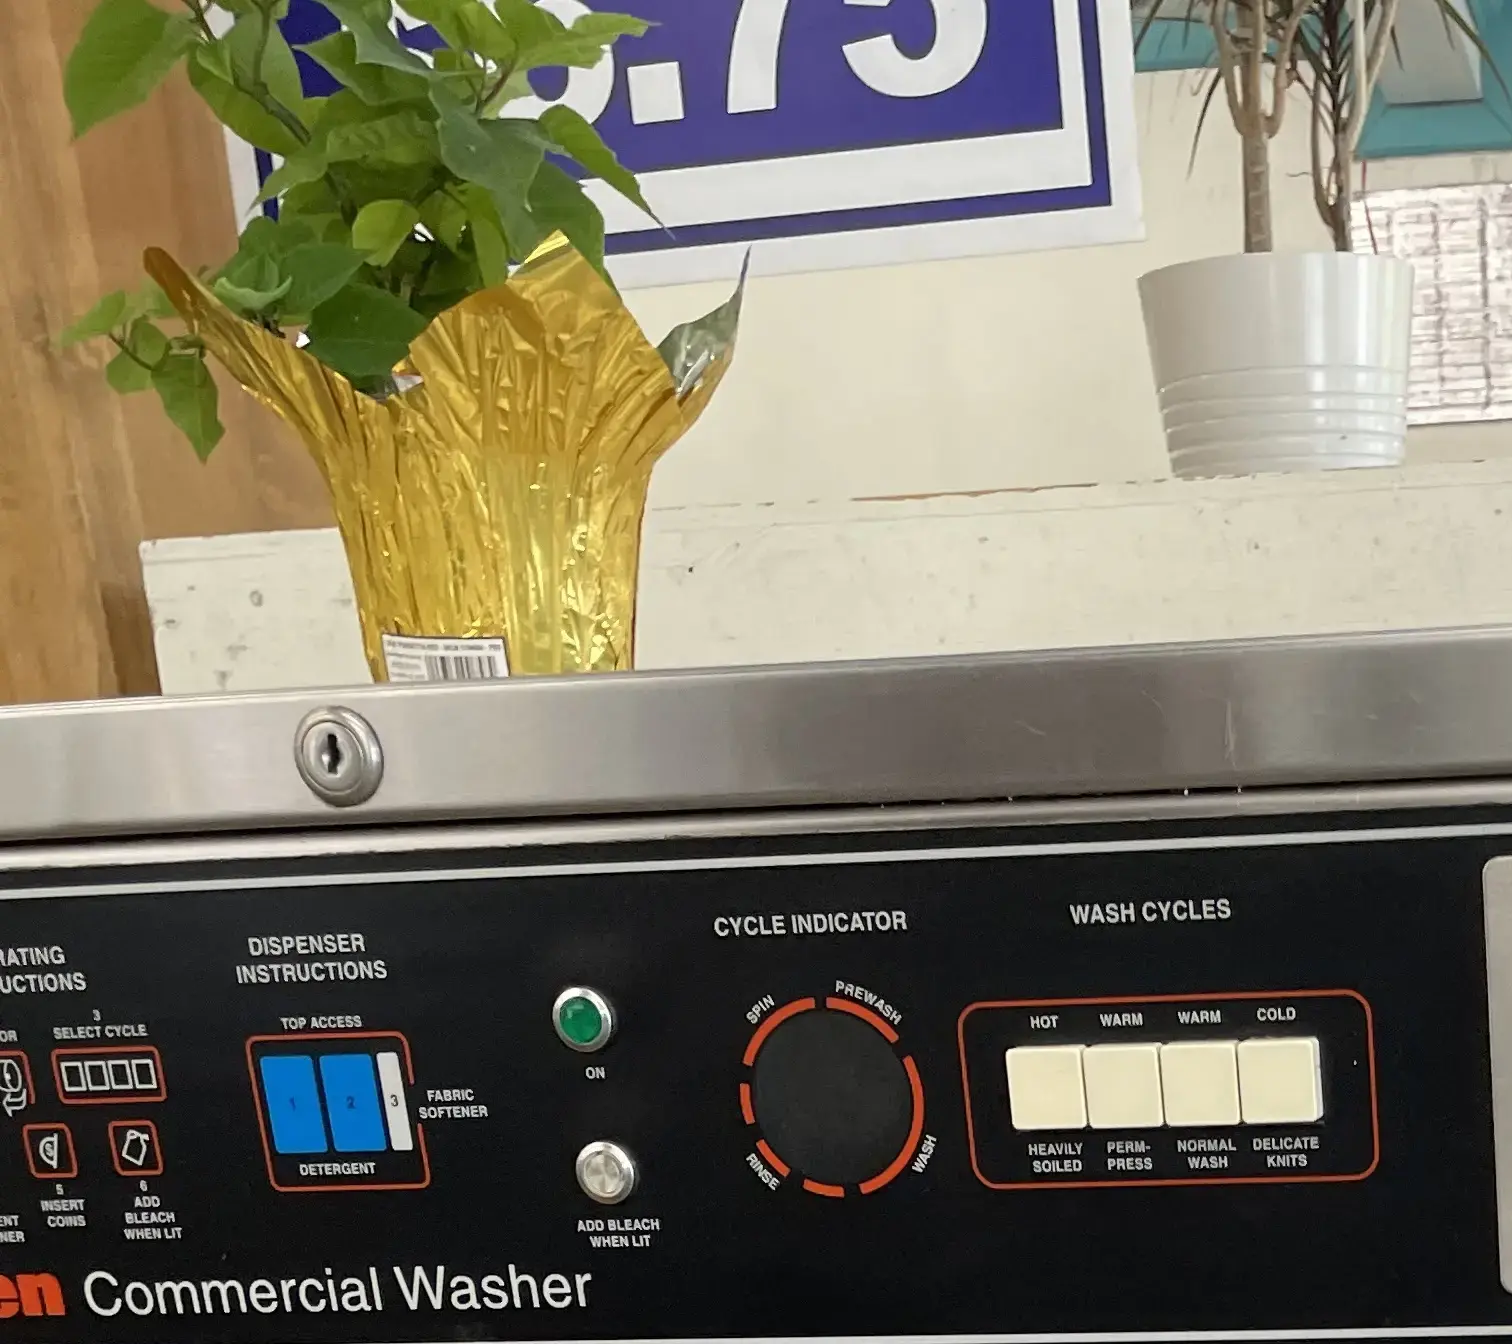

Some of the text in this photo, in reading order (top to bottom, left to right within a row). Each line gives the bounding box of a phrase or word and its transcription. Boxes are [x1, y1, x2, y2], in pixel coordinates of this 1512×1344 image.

[1069, 898, 1232, 926] WASH CYCLES
[713, 911, 908, 937] CYCLE INDICATOR
[247, 933, 366, 956] DISPENSER
[236, 960, 388, 984] INSTRUCTIONS
[745, 994, 776, 1025] SPIN
[834, 979, 903, 1026] PREWASH
[92, 1008, 102, 1022] 3
[1029, 1014, 1059, 1030] HOT
[1100, 1012, 1144, 1028] WARM
[1177, 1009, 1222, 1025] WARM
[1256, 1006, 1297, 1022] COLD
[280, 1014, 363, 1031] TOP ACCESS
[52, 1023, 150, 1041] SELECT CYCLE
[585, 1066, 606, 1080] ON
[346, 1095, 357, 1110] 2
[390, 1094, 400, 1108] 3
[426, 1088, 475, 1103] FABRIC
[418, 1104, 489, 1120] SOFTENER
[1028, 1142, 1084, 1158] HEAVILY
[1106, 1141, 1152, 1156] PERM-
[1177, 1139, 1237, 1154] NORMAL
[1252, 1136, 1320, 1152] DELICATE
[911, 1134, 938, 1175] WASH
[1188, 1155, 1229, 1170] WASH
[1266, 1152, 1308, 1168] KNITS
[299, 1161, 377, 1177] DETERGENT
[745, 1151, 781, 1192] RINSE
[1032, 1158, 1083, 1173] SOILED
[1107, 1156, 1153, 1171] PRESS
[55, 1183, 65, 1196] 5
[139, 1179, 149, 1192] 6
[40, 1198, 86, 1212] INSERT
[134, 1195, 161, 1209] ADD
[47, 1214, 87, 1228] COINS
[124, 1211, 176, 1225] BLEACH
[577, 1218, 661, 1233] ADD BLEACH
[123, 1226, 183, 1241] WHEN LIT
[588, 1234, 651, 1249] WHEN LIT
[84, 1263, 593, 1316] Commercial Washer
